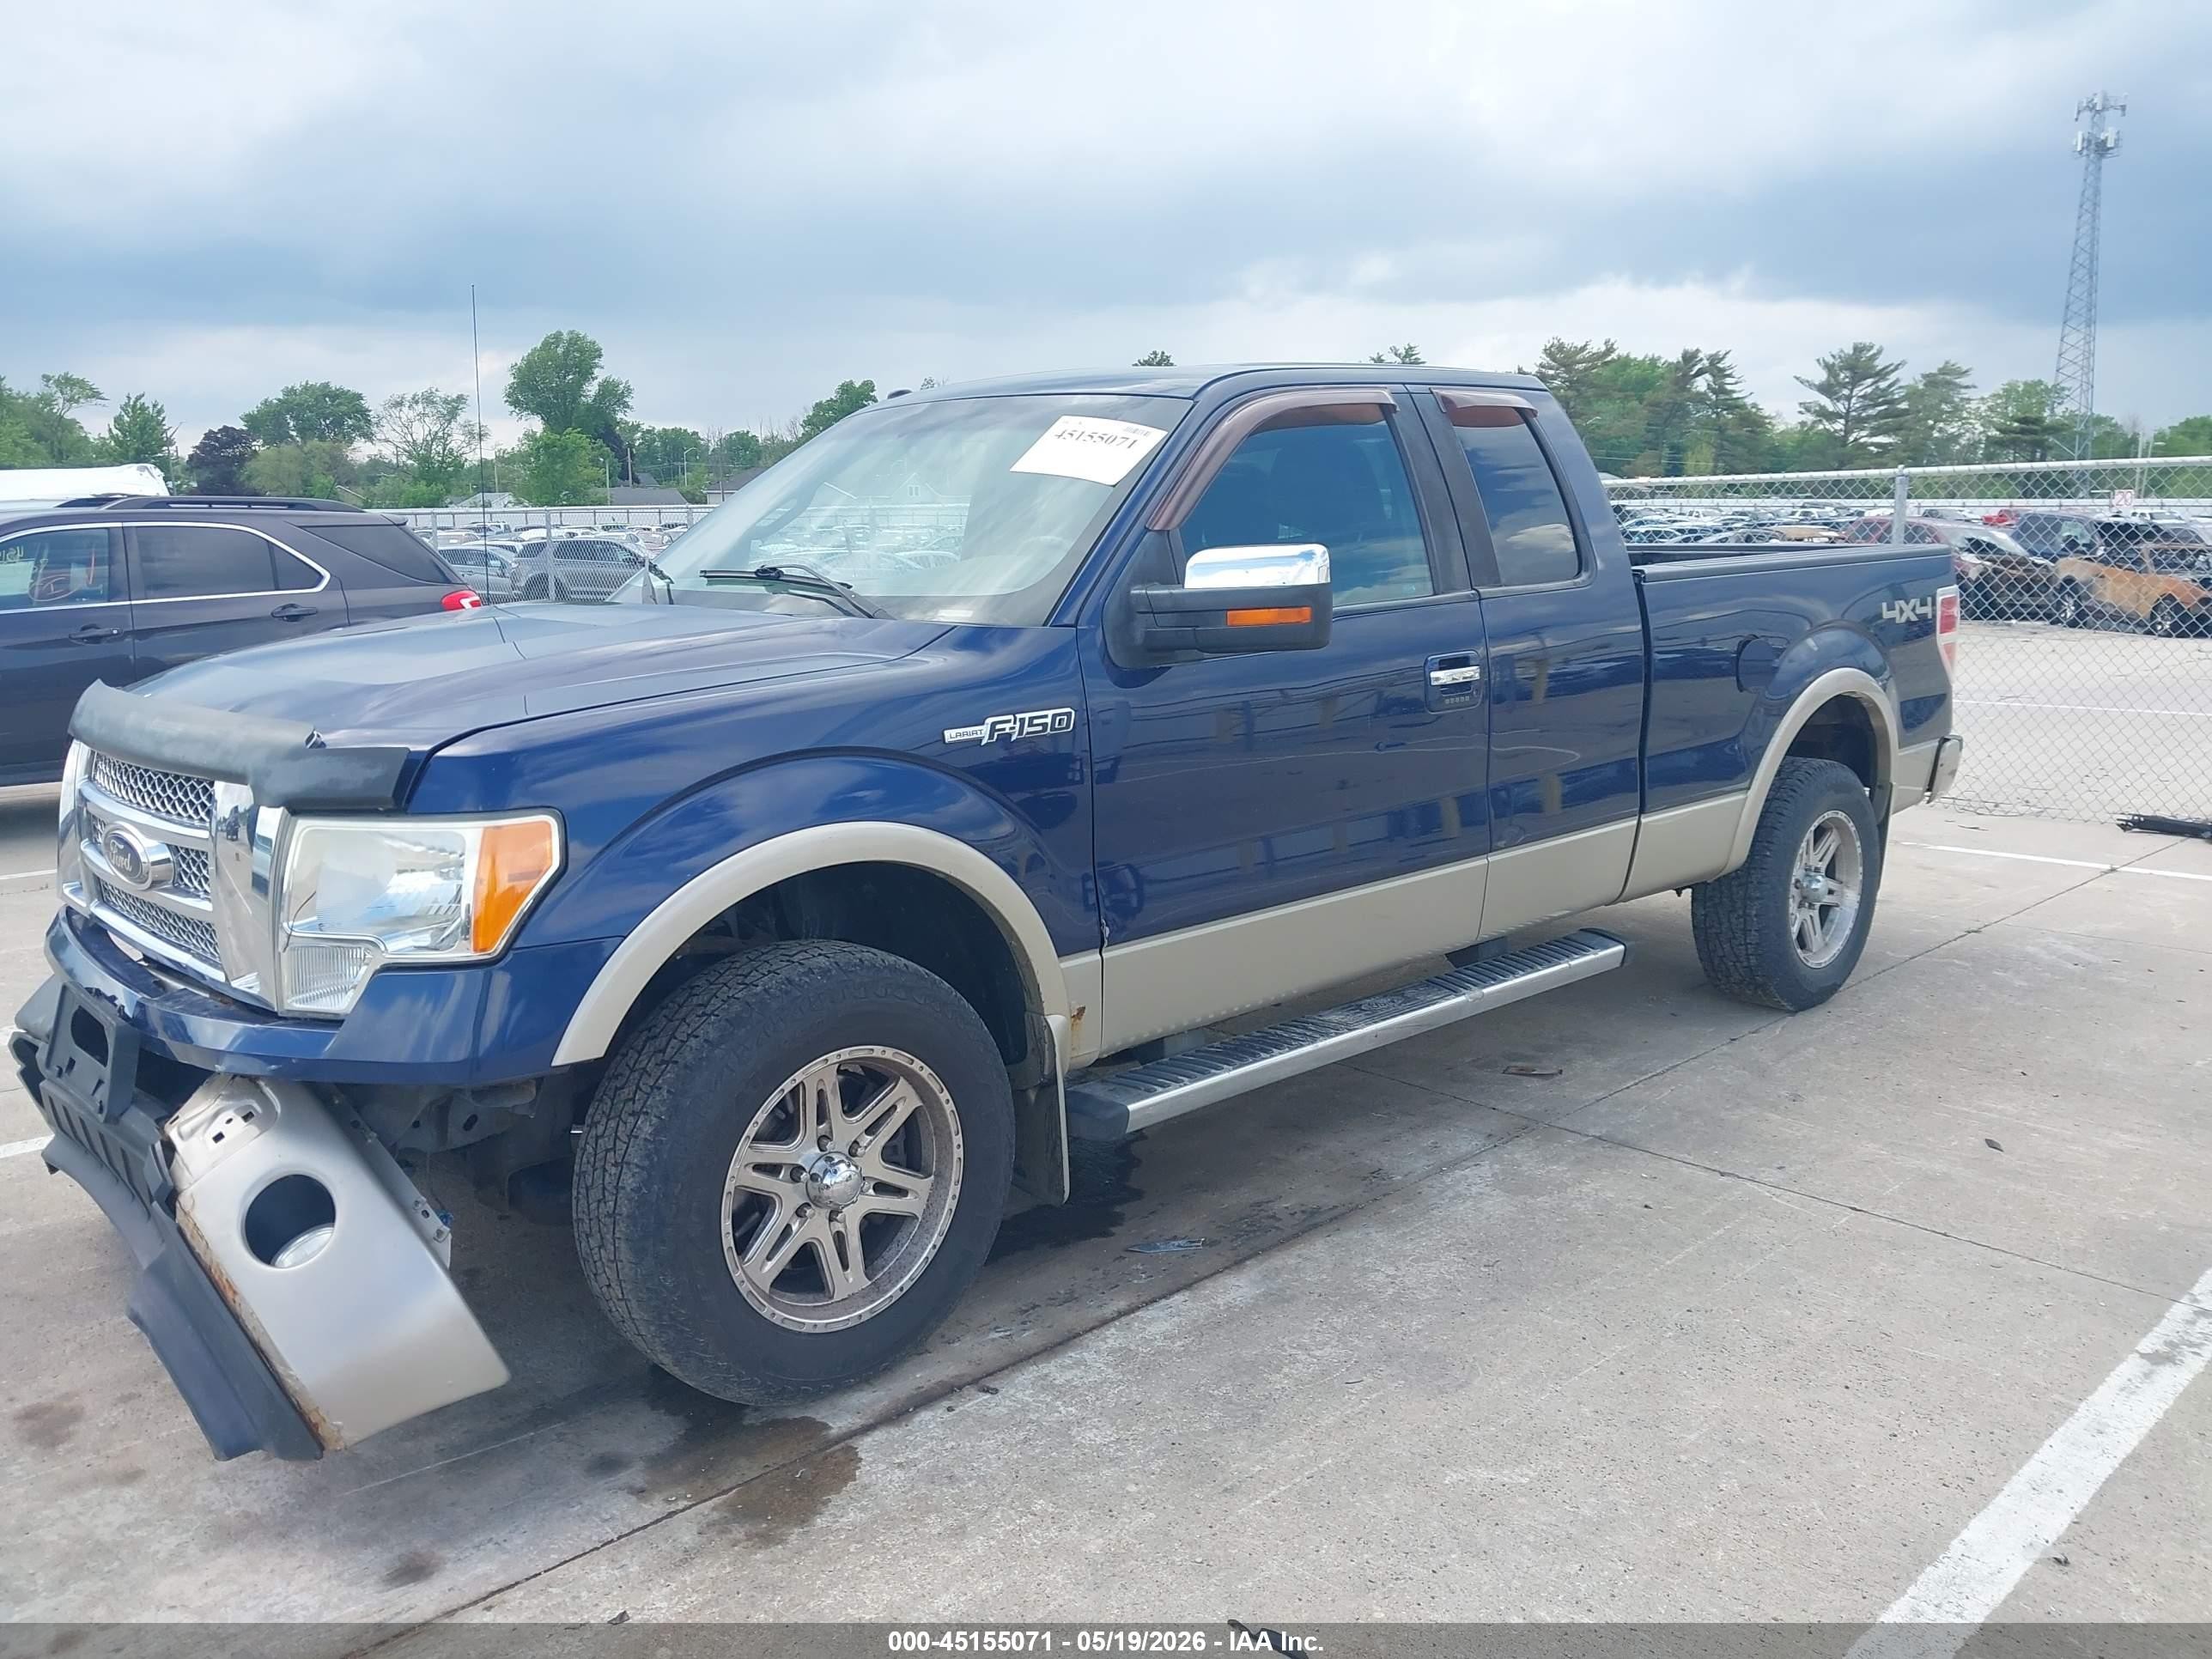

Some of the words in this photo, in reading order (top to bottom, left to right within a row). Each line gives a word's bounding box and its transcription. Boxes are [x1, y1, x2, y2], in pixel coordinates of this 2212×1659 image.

[1054, 428, 1138, 449] 45155071
[949, 729, 983, 740] LARIAT
[986, 709, 1073, 742] F-150
[109, 839, 132, 872] Ford
